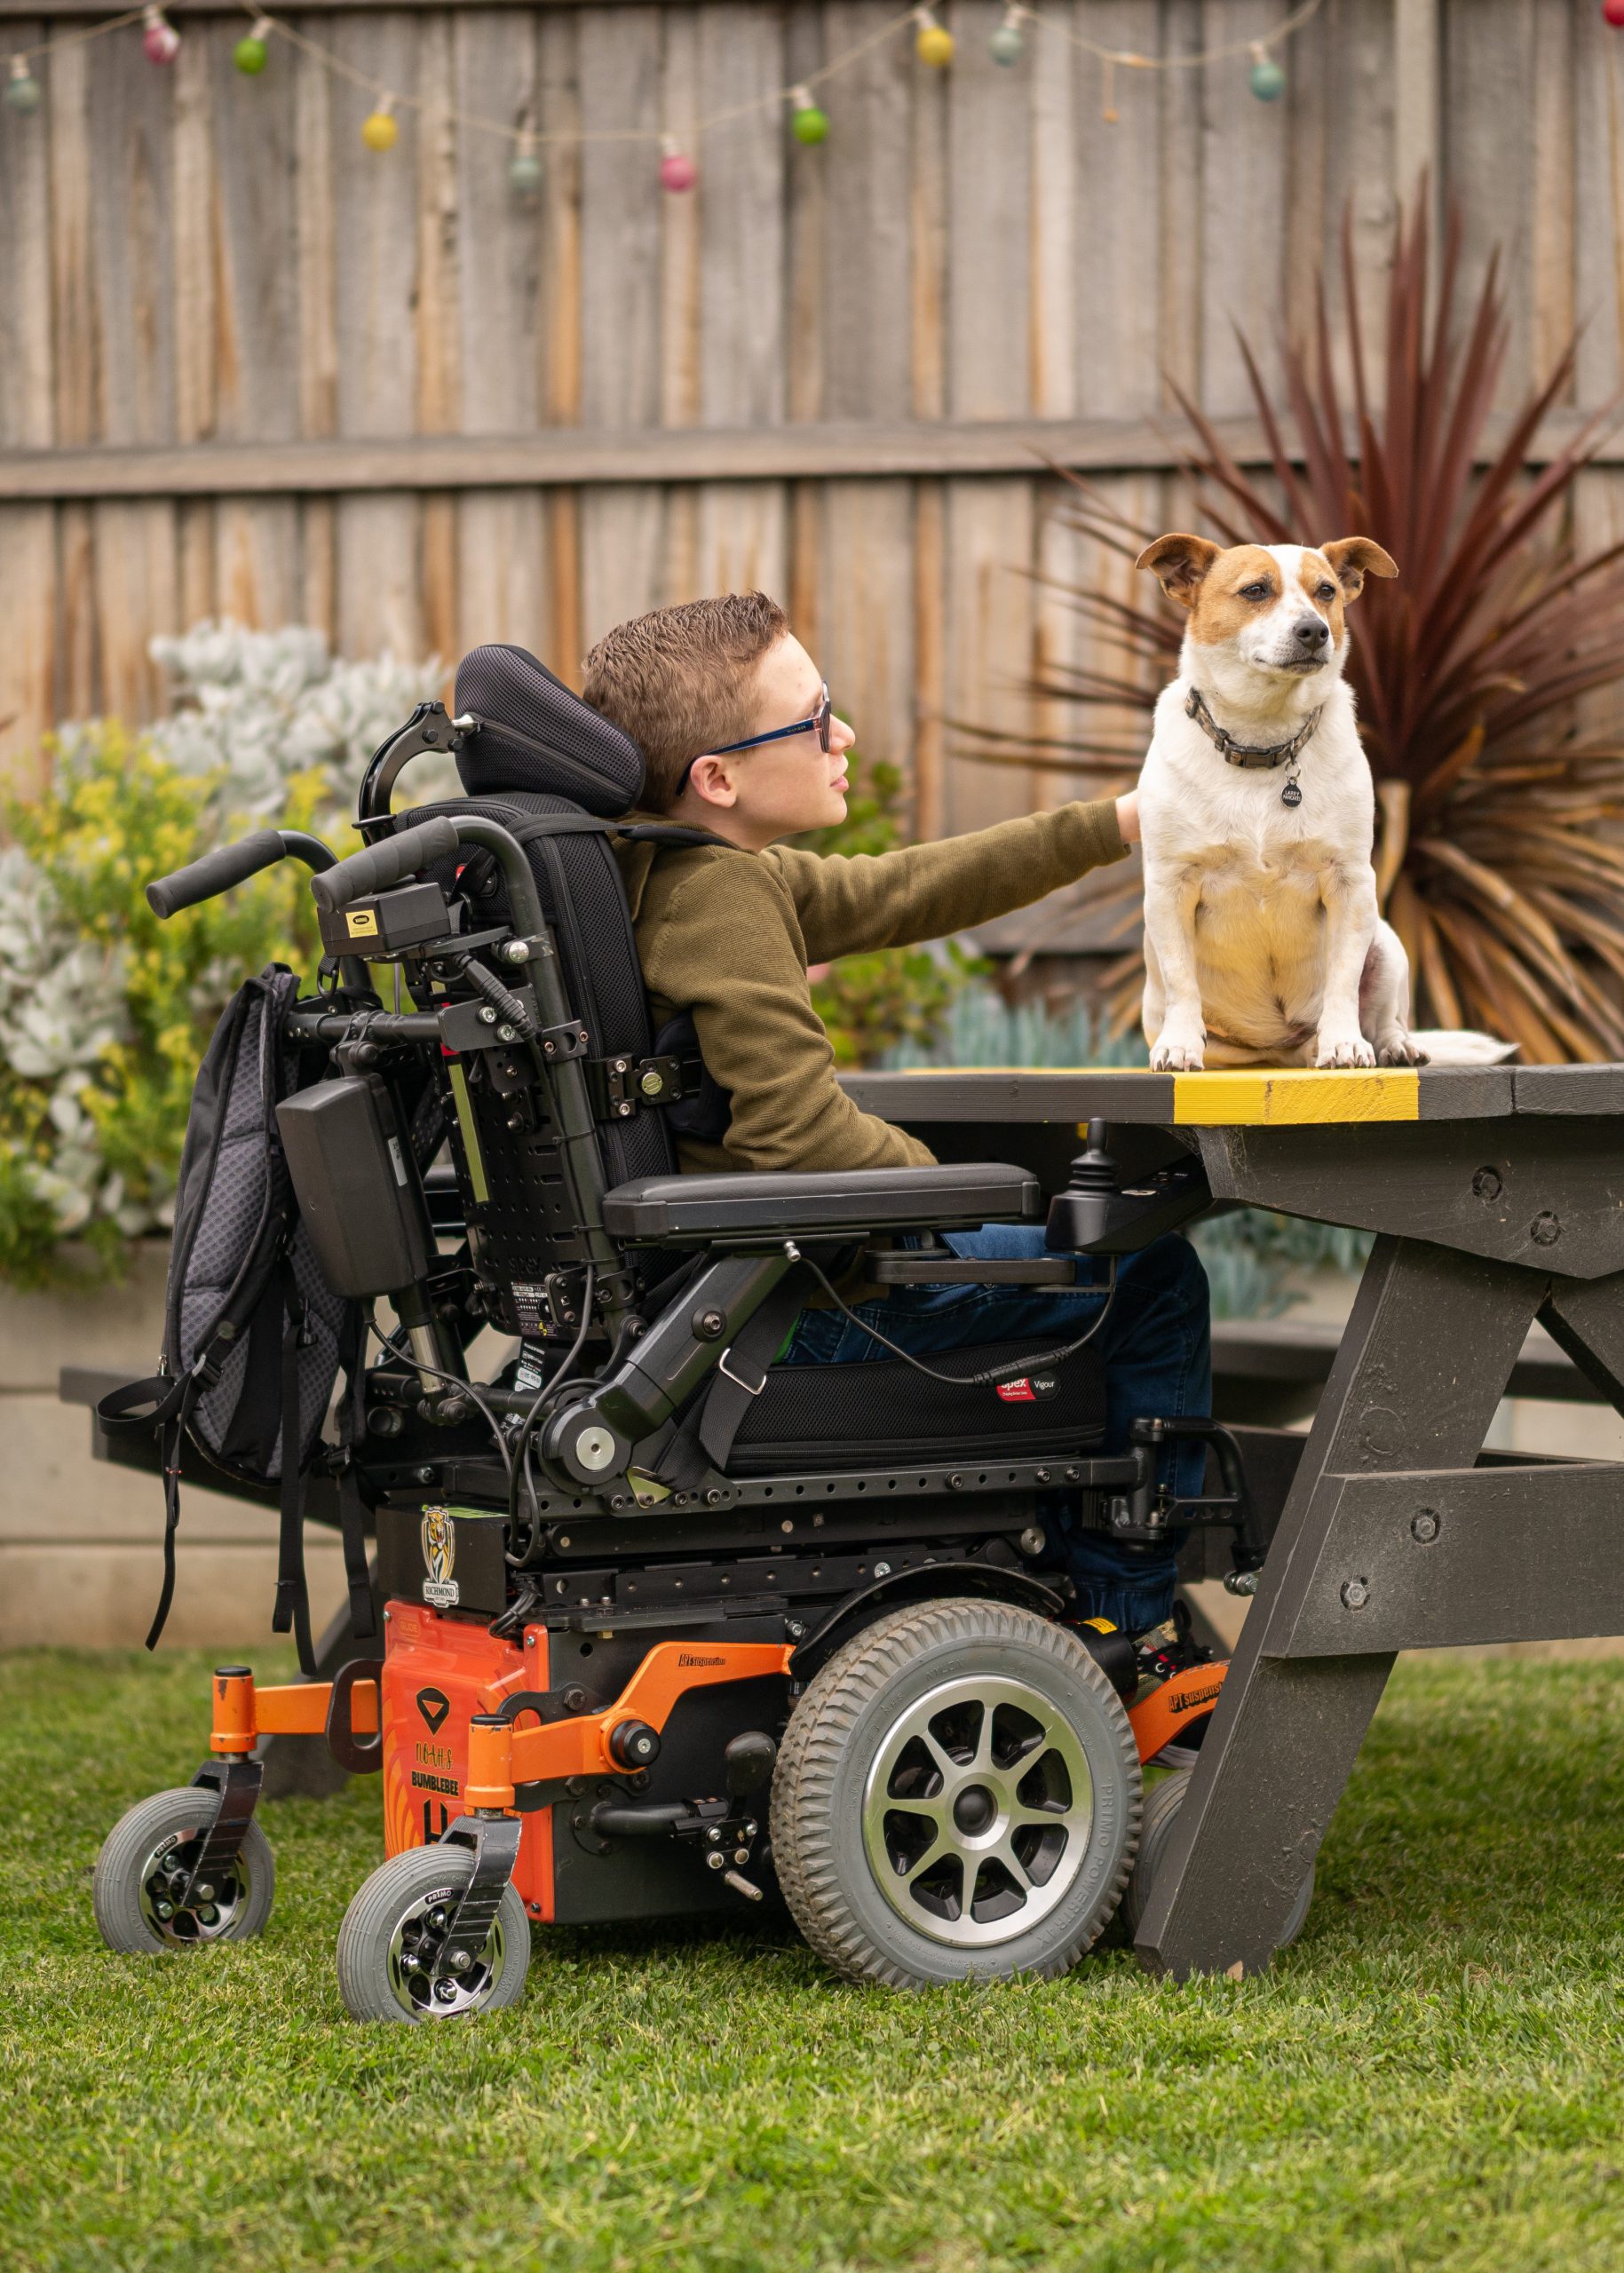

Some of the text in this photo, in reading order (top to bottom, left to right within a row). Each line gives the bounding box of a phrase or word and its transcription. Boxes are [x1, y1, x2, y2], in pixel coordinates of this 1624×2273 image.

[1034, 1380, 1055, 1390] Vigour
[425, 1586, 455, 1597] RICHMOND
[1168, 1693, 1184, 1713] APT
[411, 1770, 459, 1797] BUMBLEBEE
[1100, 1783, 1113, 1849] PRIMO
[427, 1889, 452, 1904] PRIMO
